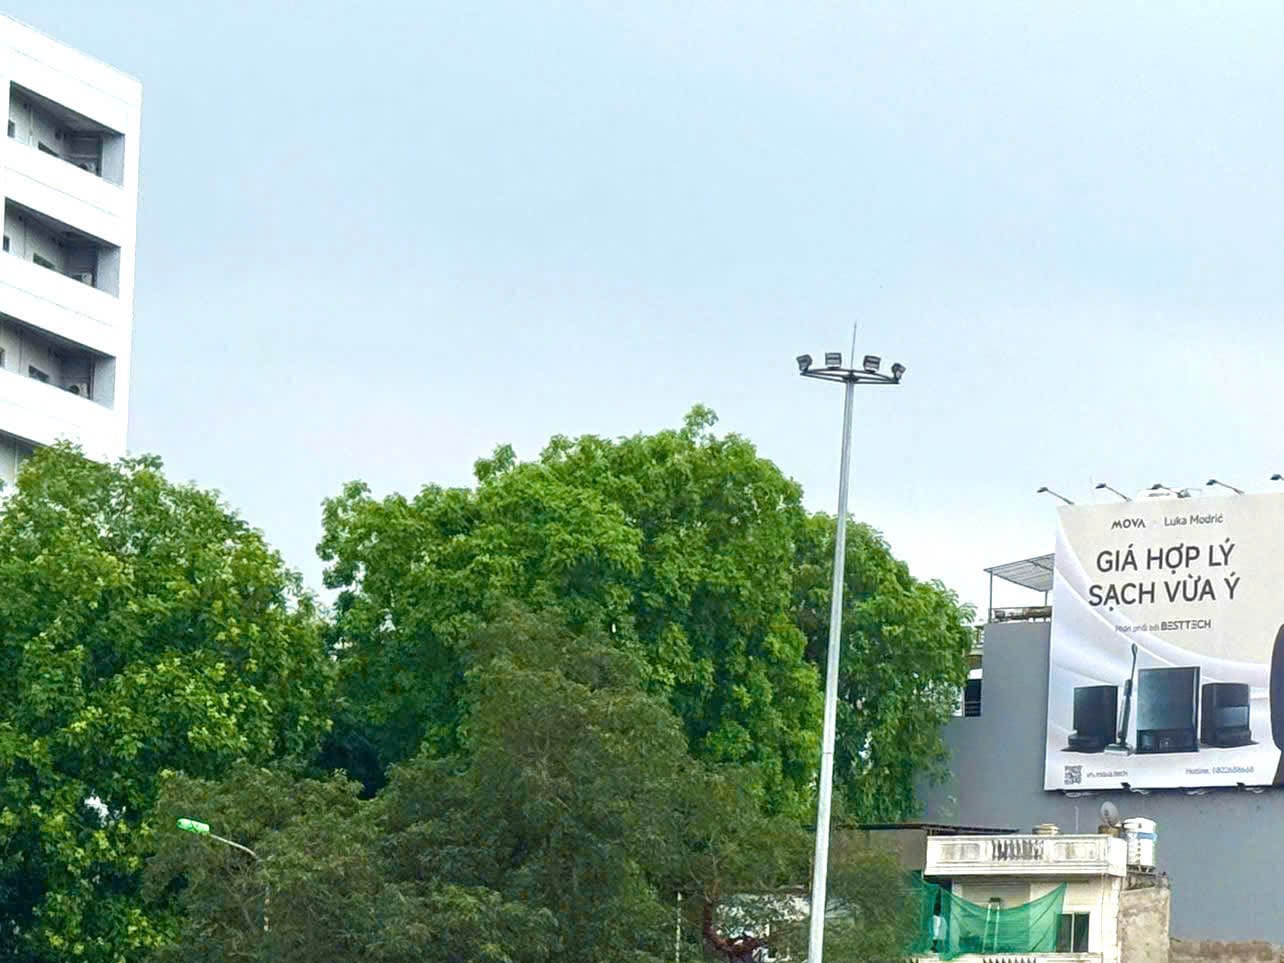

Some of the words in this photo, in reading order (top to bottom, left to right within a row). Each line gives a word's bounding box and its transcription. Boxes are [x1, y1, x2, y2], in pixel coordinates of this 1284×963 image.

[1111, 518, 1146, 530] MOVA
[1164, 516, 1187, 527] Luka
[1190, 513, 1224, 525] Modrić
[1096, 543, 1138, 573] GIÁ
[1147, 542, 1200, 575] HỢP
[1208, 537, 1235, 567] LÝ
[1088, 581, 1155, 611] SẠCH
[1164, 573, 1216, 602] VỪA
[1224, 571, 1240, 600] Ý
[1161, 619, 1211, 631] BESTTECH
